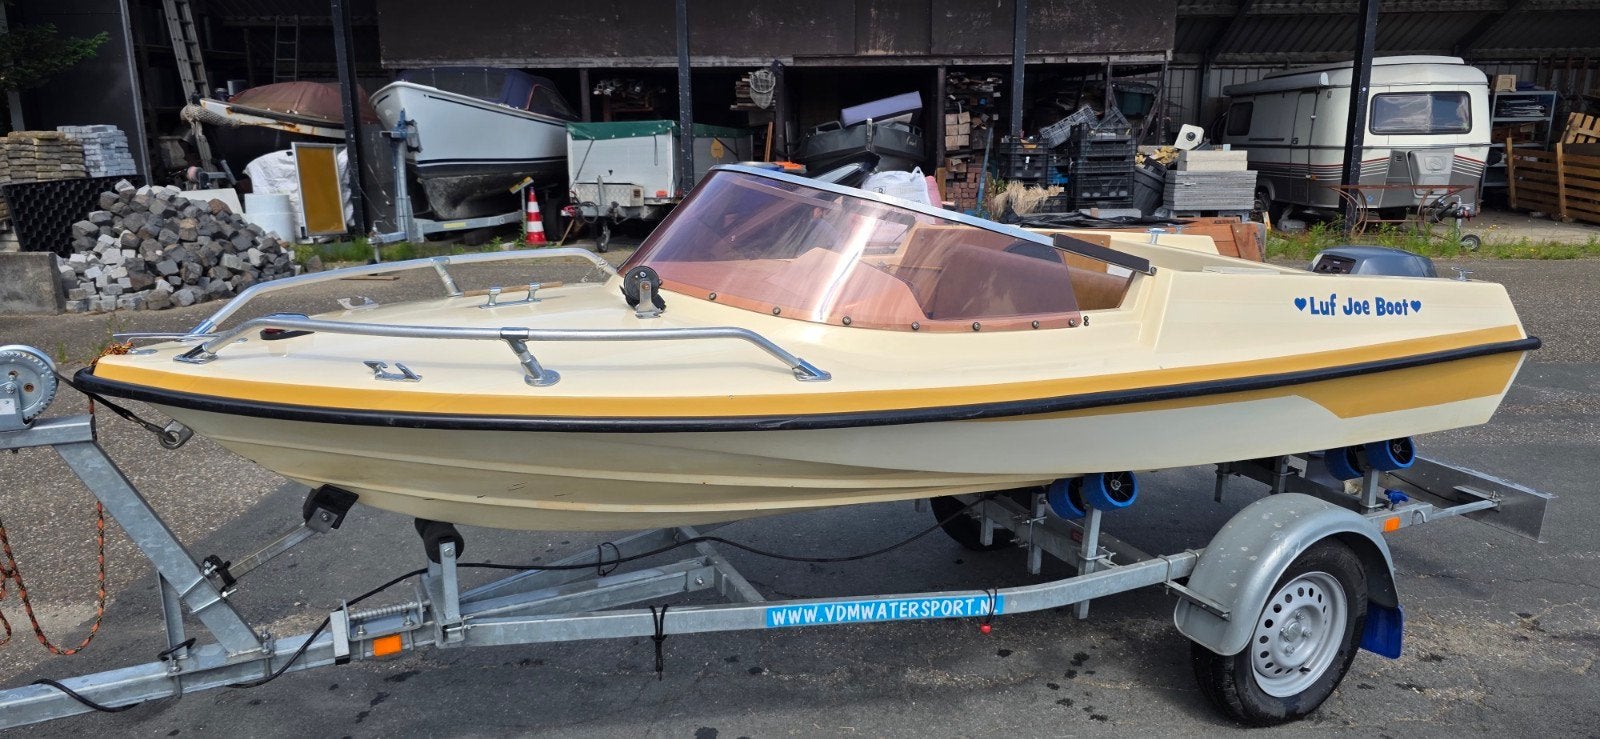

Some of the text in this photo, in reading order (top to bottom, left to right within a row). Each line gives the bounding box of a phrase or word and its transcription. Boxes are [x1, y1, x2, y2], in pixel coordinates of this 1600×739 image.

[1309, 293, 1408, 316] Luf Joe Boot
